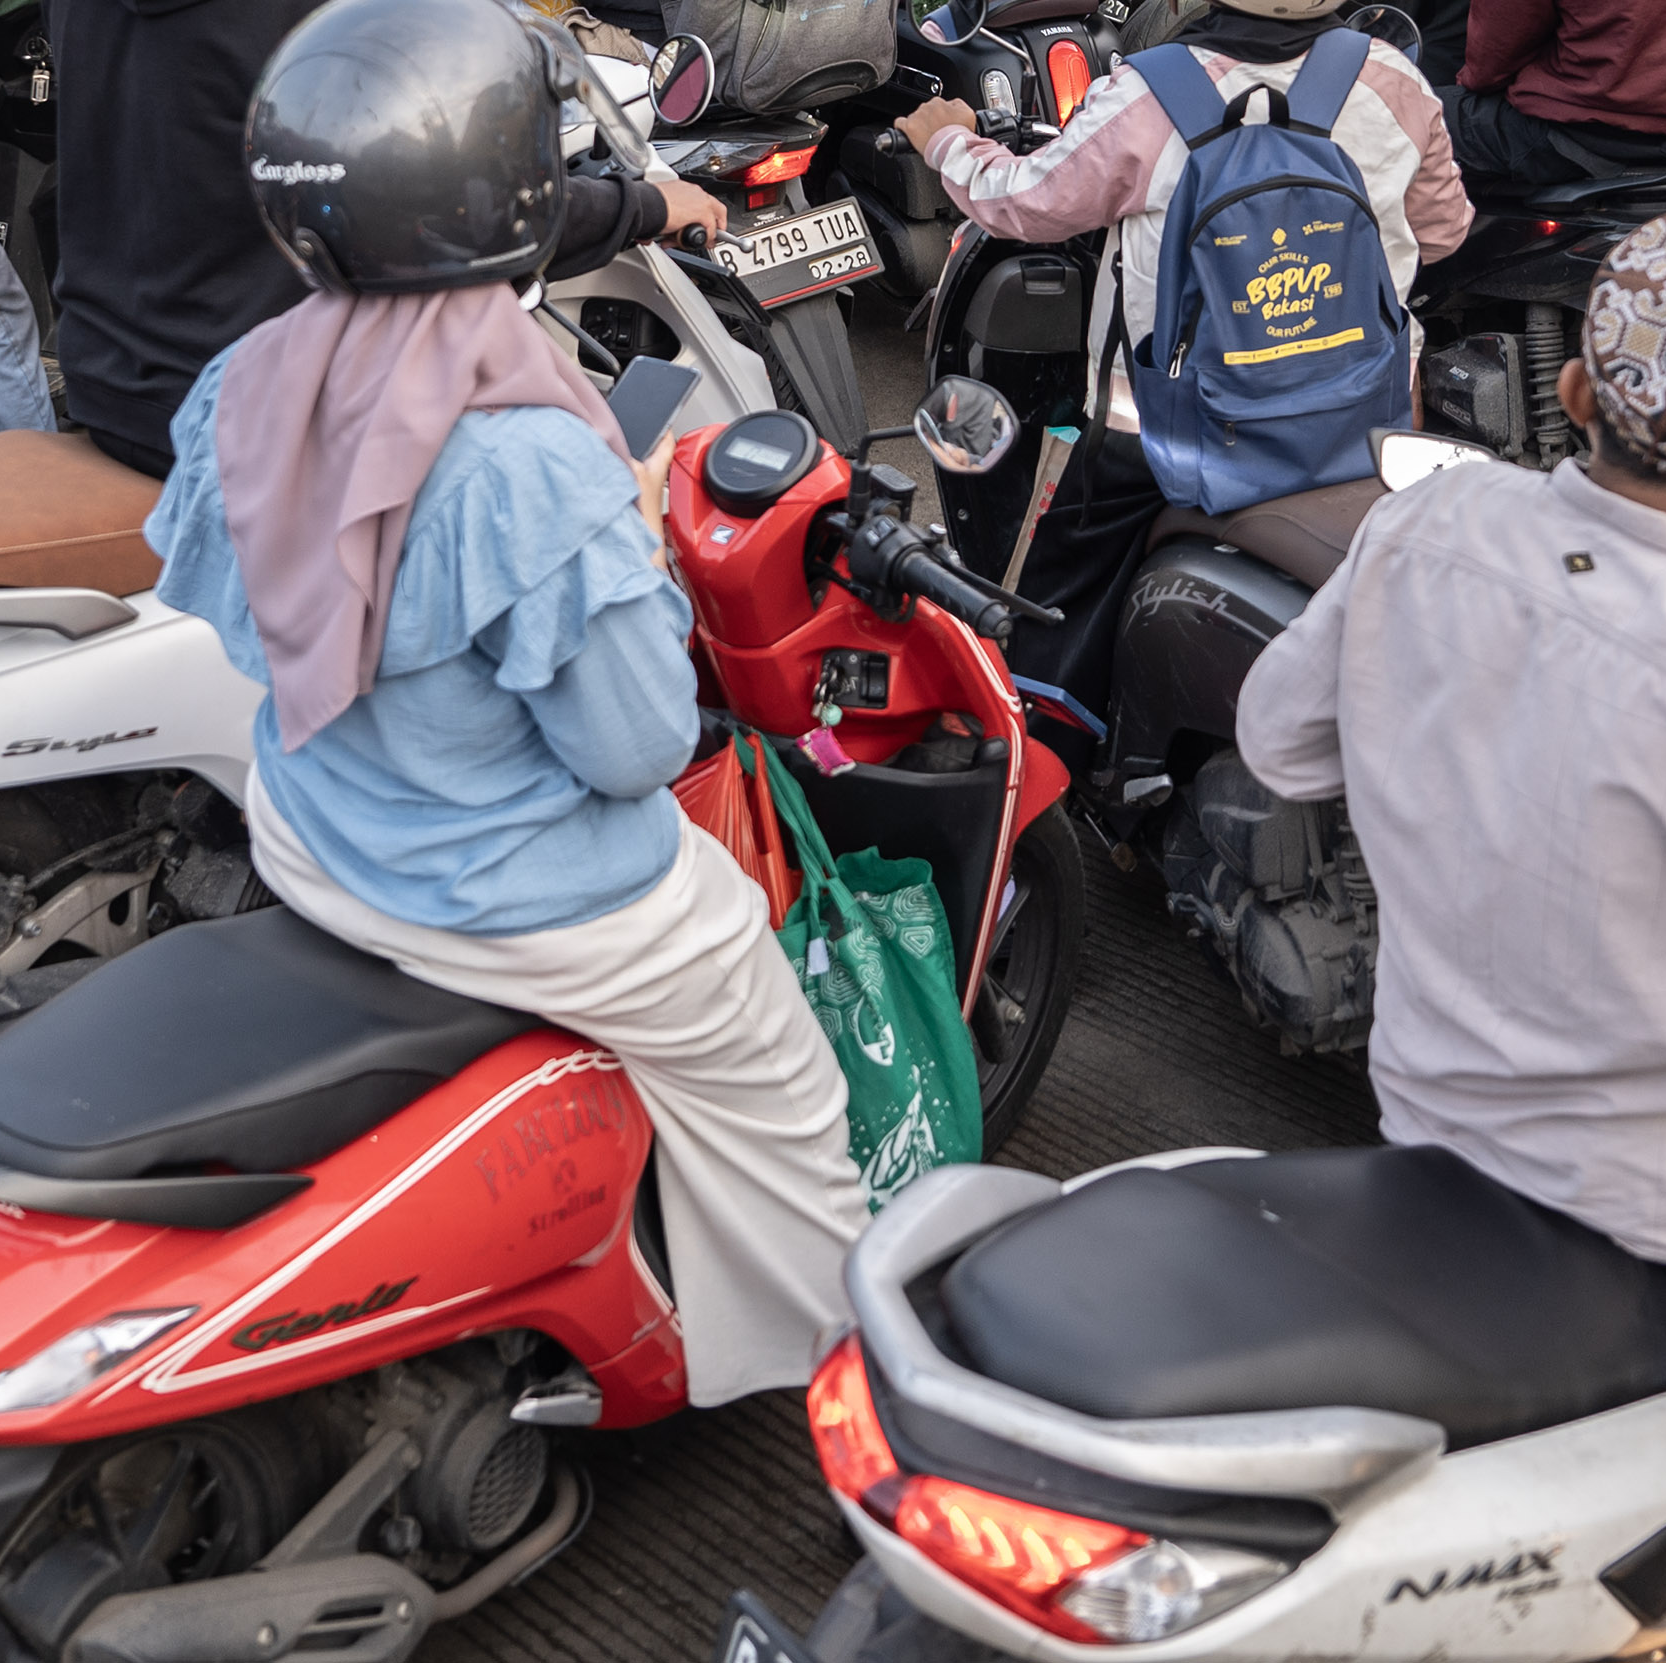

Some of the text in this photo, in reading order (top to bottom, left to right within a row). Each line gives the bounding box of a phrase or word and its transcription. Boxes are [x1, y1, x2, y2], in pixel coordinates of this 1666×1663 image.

[1040, 25, 1074, 37] YAMAHA
[251, 156, 347, 186] Cargloss
[812, 211, 860, 245] TUA
[1257, 252, 1310, 274] OUR SKILLS
[1246, 262, 1332, 306] BBPVP
[1261, 294, 1316, 321] Bekasi
[1266, 316, 1318, 338] OUR FUTURE
